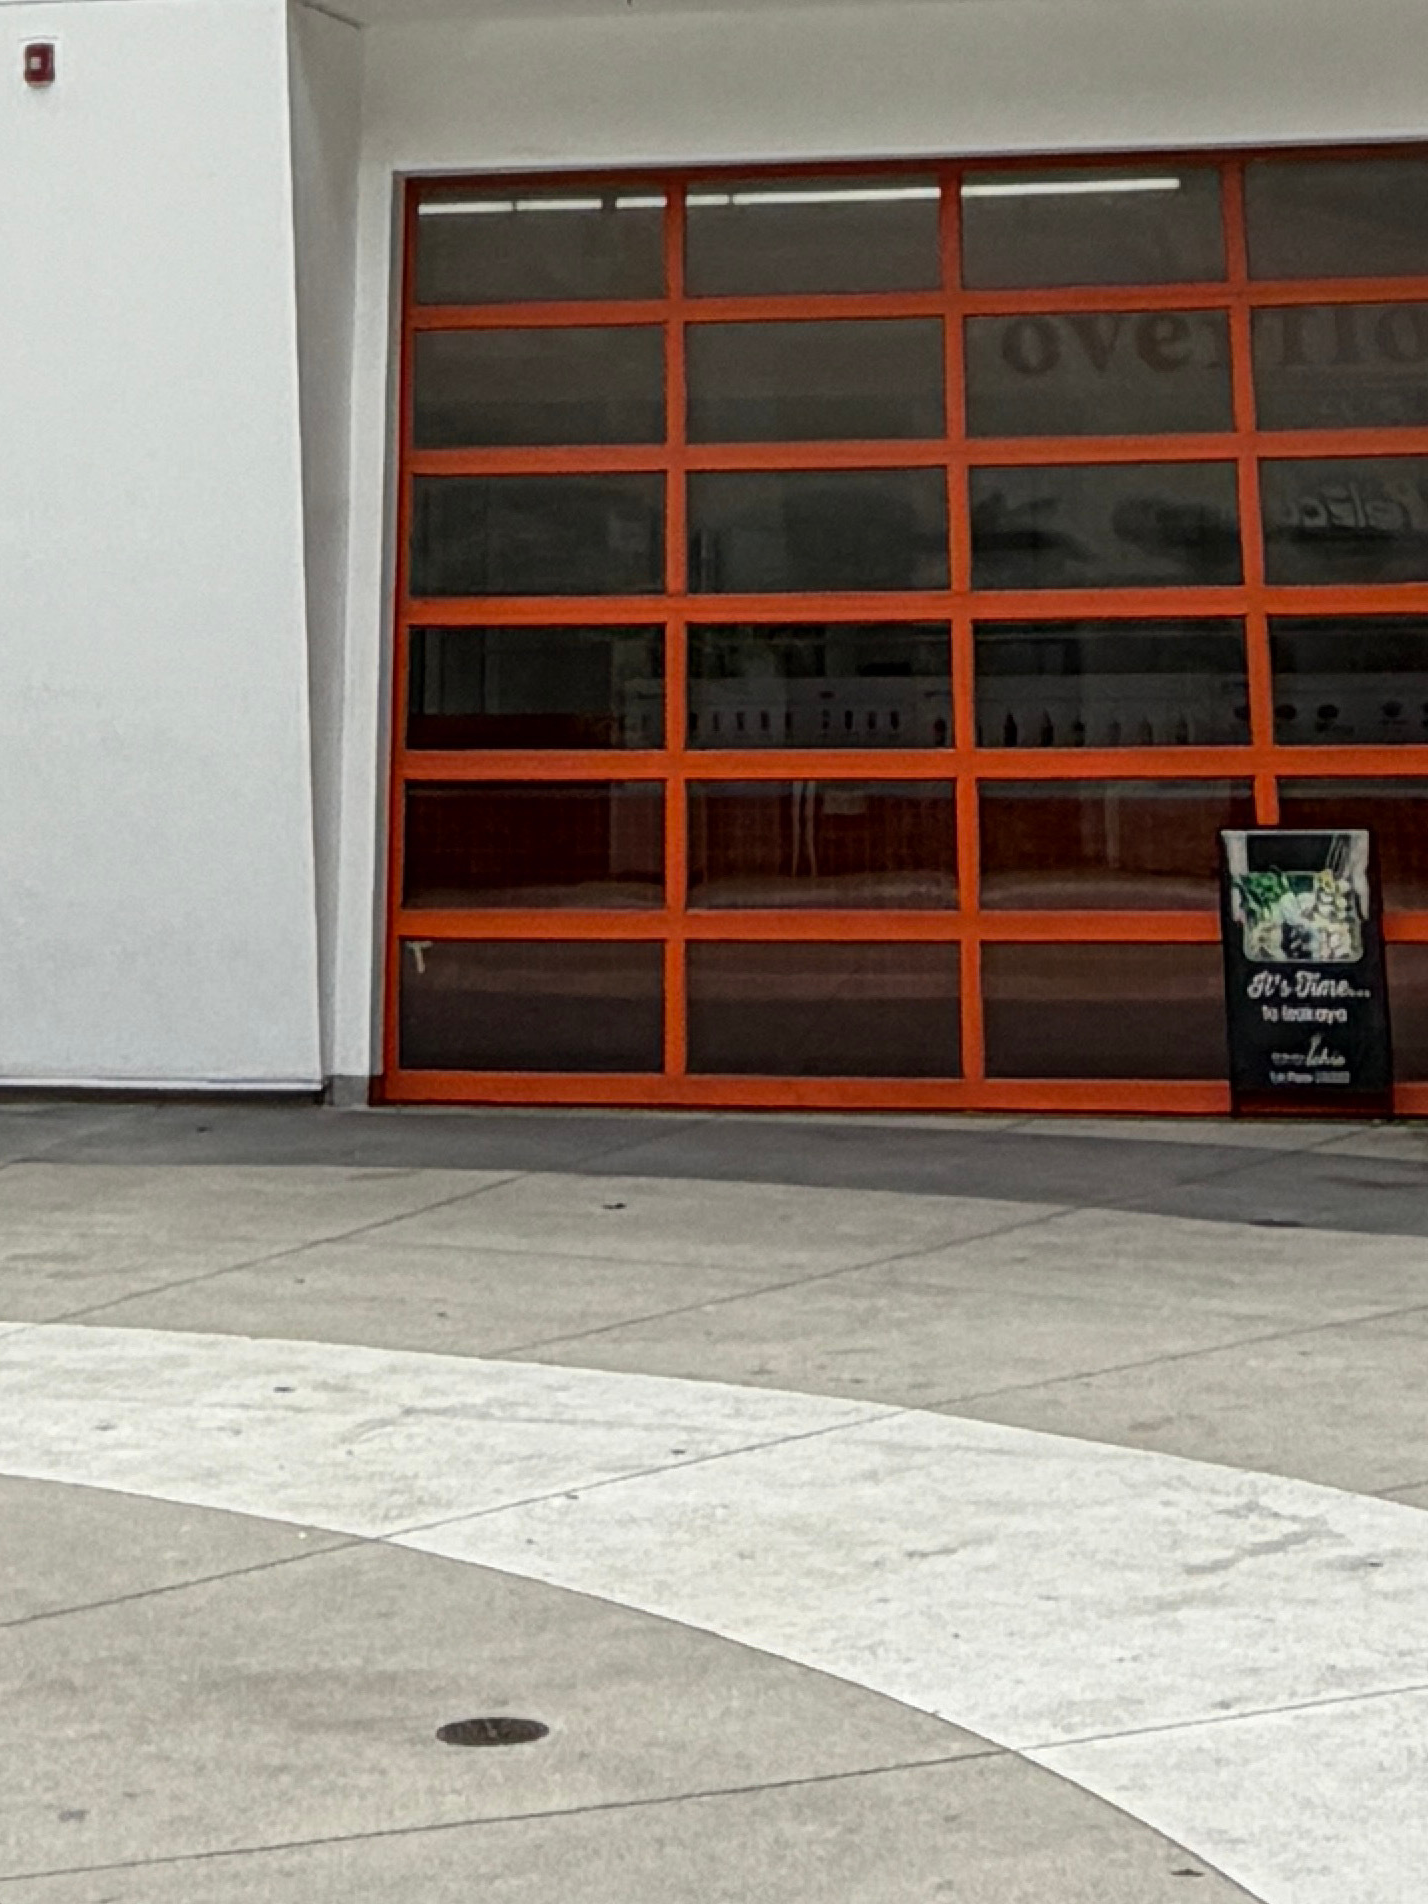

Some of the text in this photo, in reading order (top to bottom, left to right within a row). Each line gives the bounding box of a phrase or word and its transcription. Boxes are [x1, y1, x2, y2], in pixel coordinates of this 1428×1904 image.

[1247, 970, 1372, 1000] It's Time...
[1262, 1004, 1279, 1024] to
